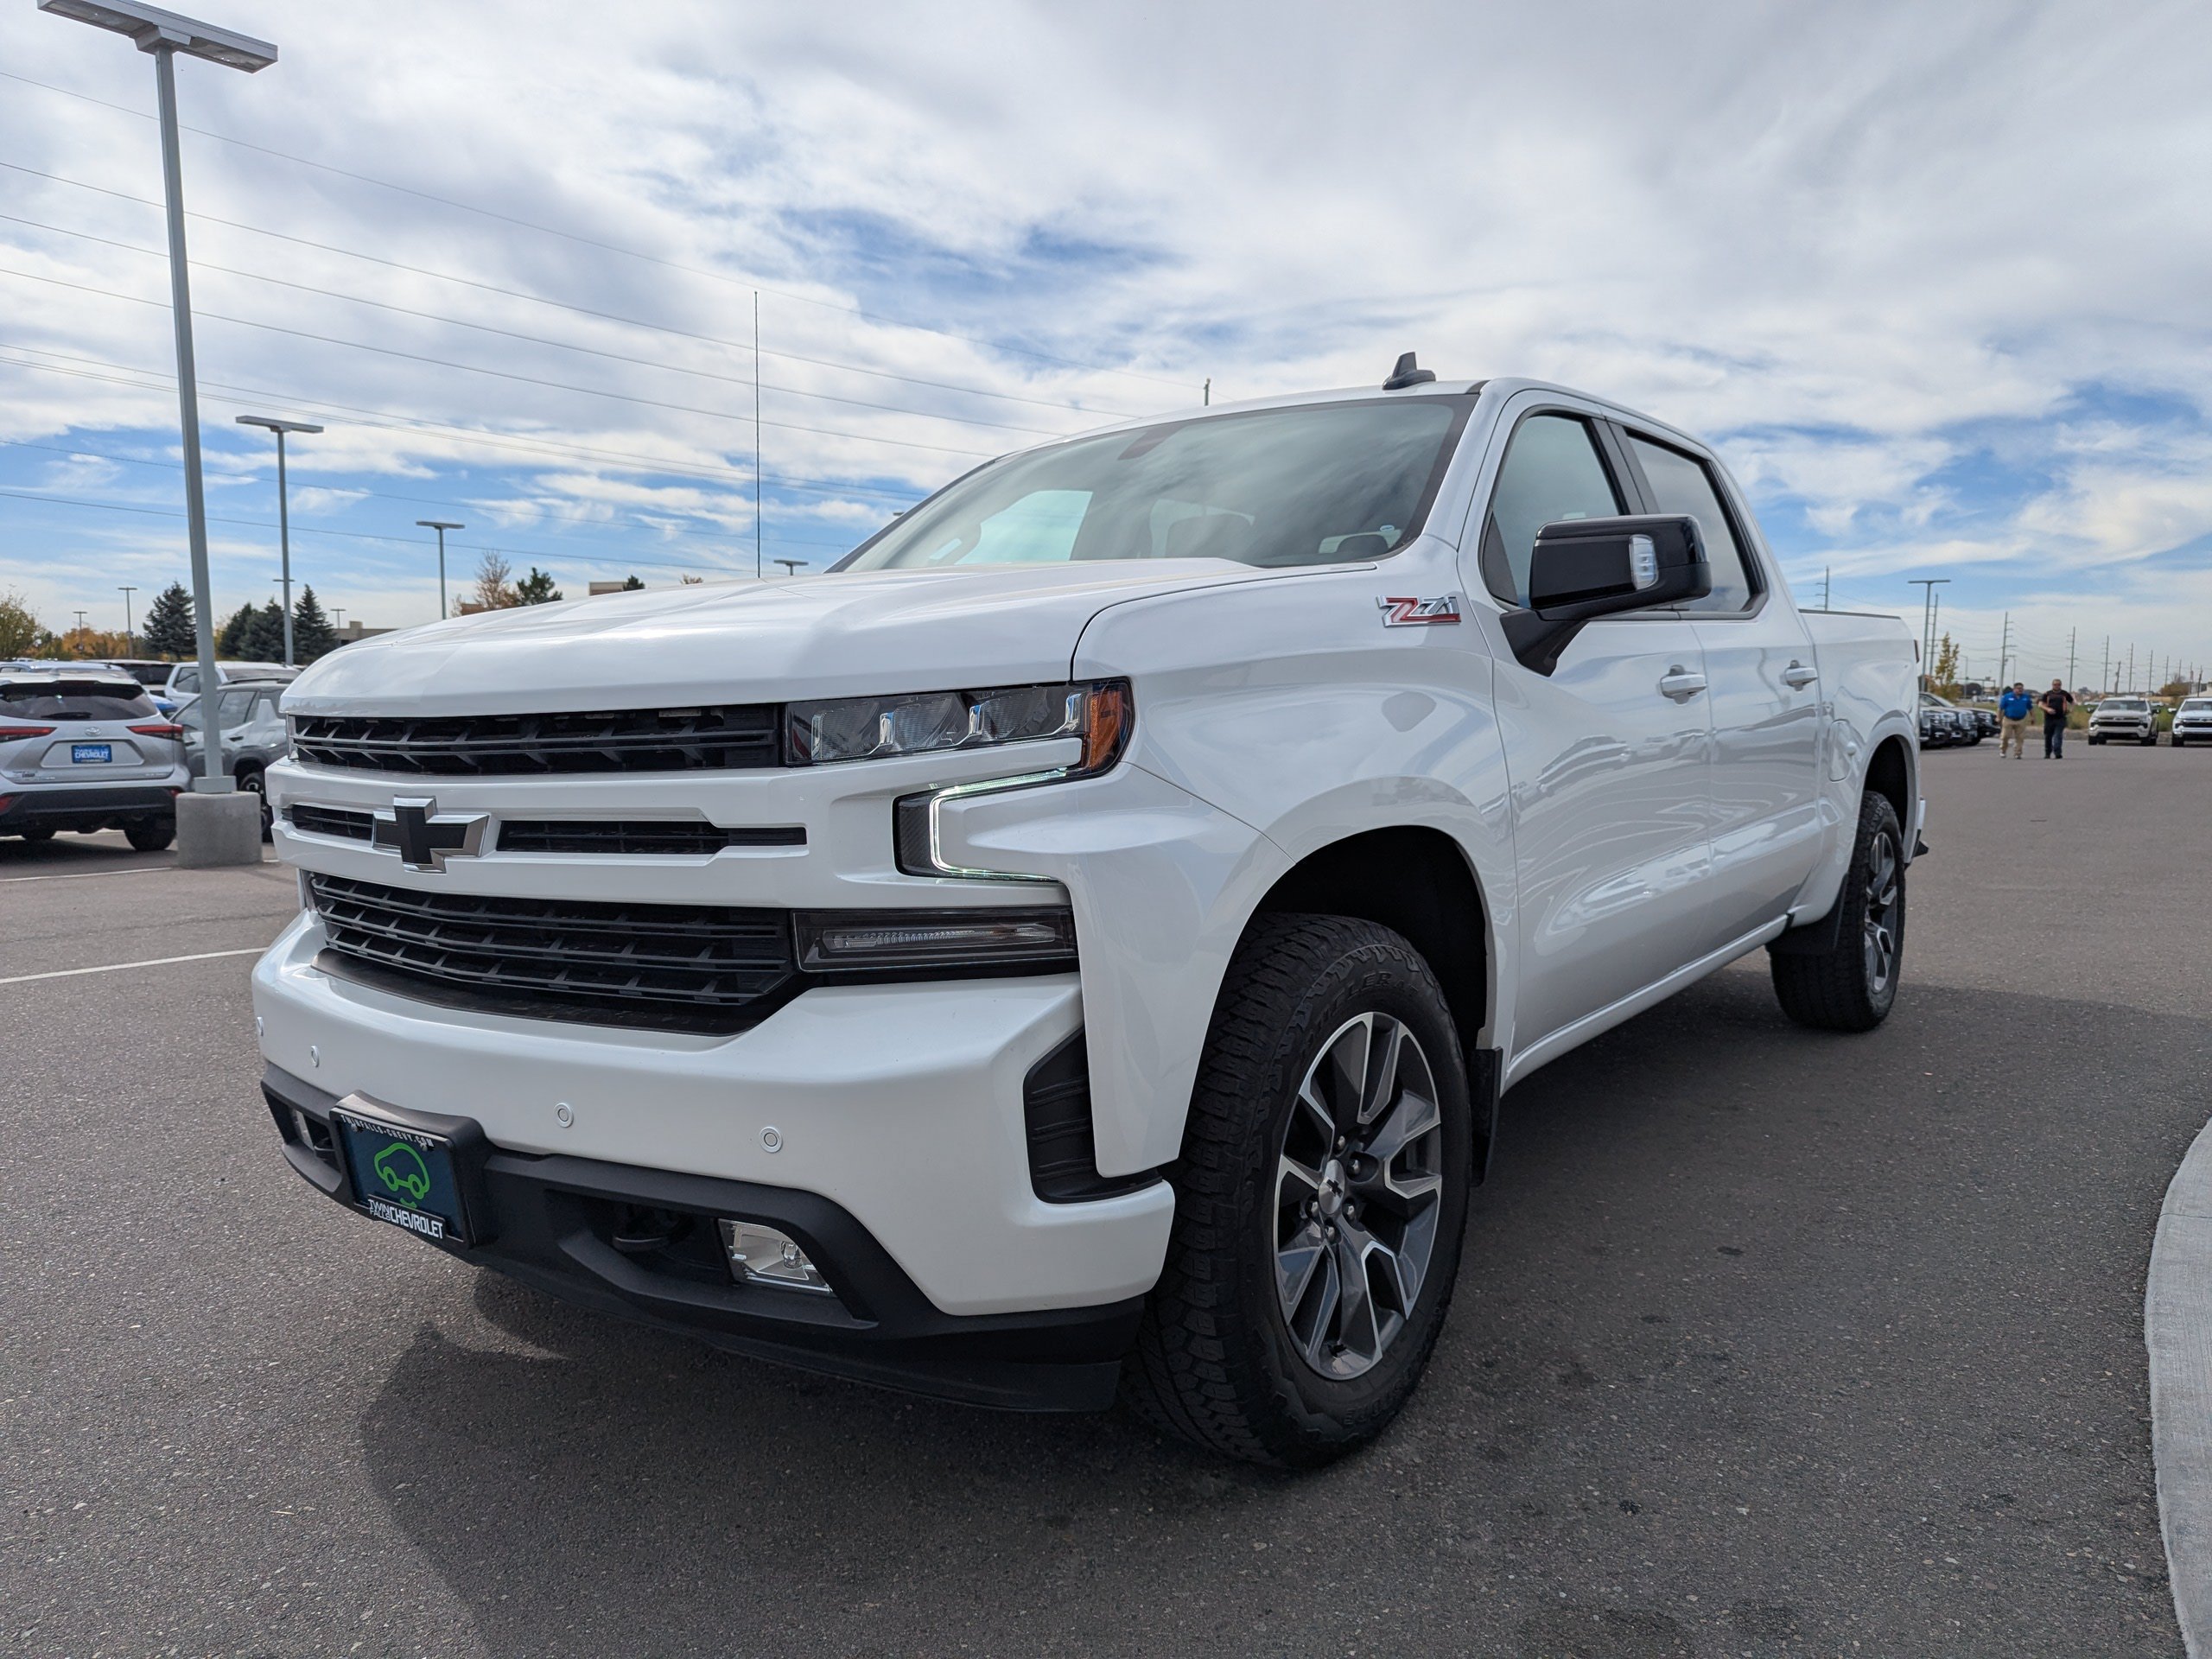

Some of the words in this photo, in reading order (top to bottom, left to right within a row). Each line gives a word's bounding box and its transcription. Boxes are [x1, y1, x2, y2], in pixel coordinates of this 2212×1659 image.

[1376, 595, 1461, 627] Z71
[368, 1198, 390, 1214] TWIN
[390, 1205, 443, 1240] CHEVROLET
[370, 1207, 391, 1221] FALLS
